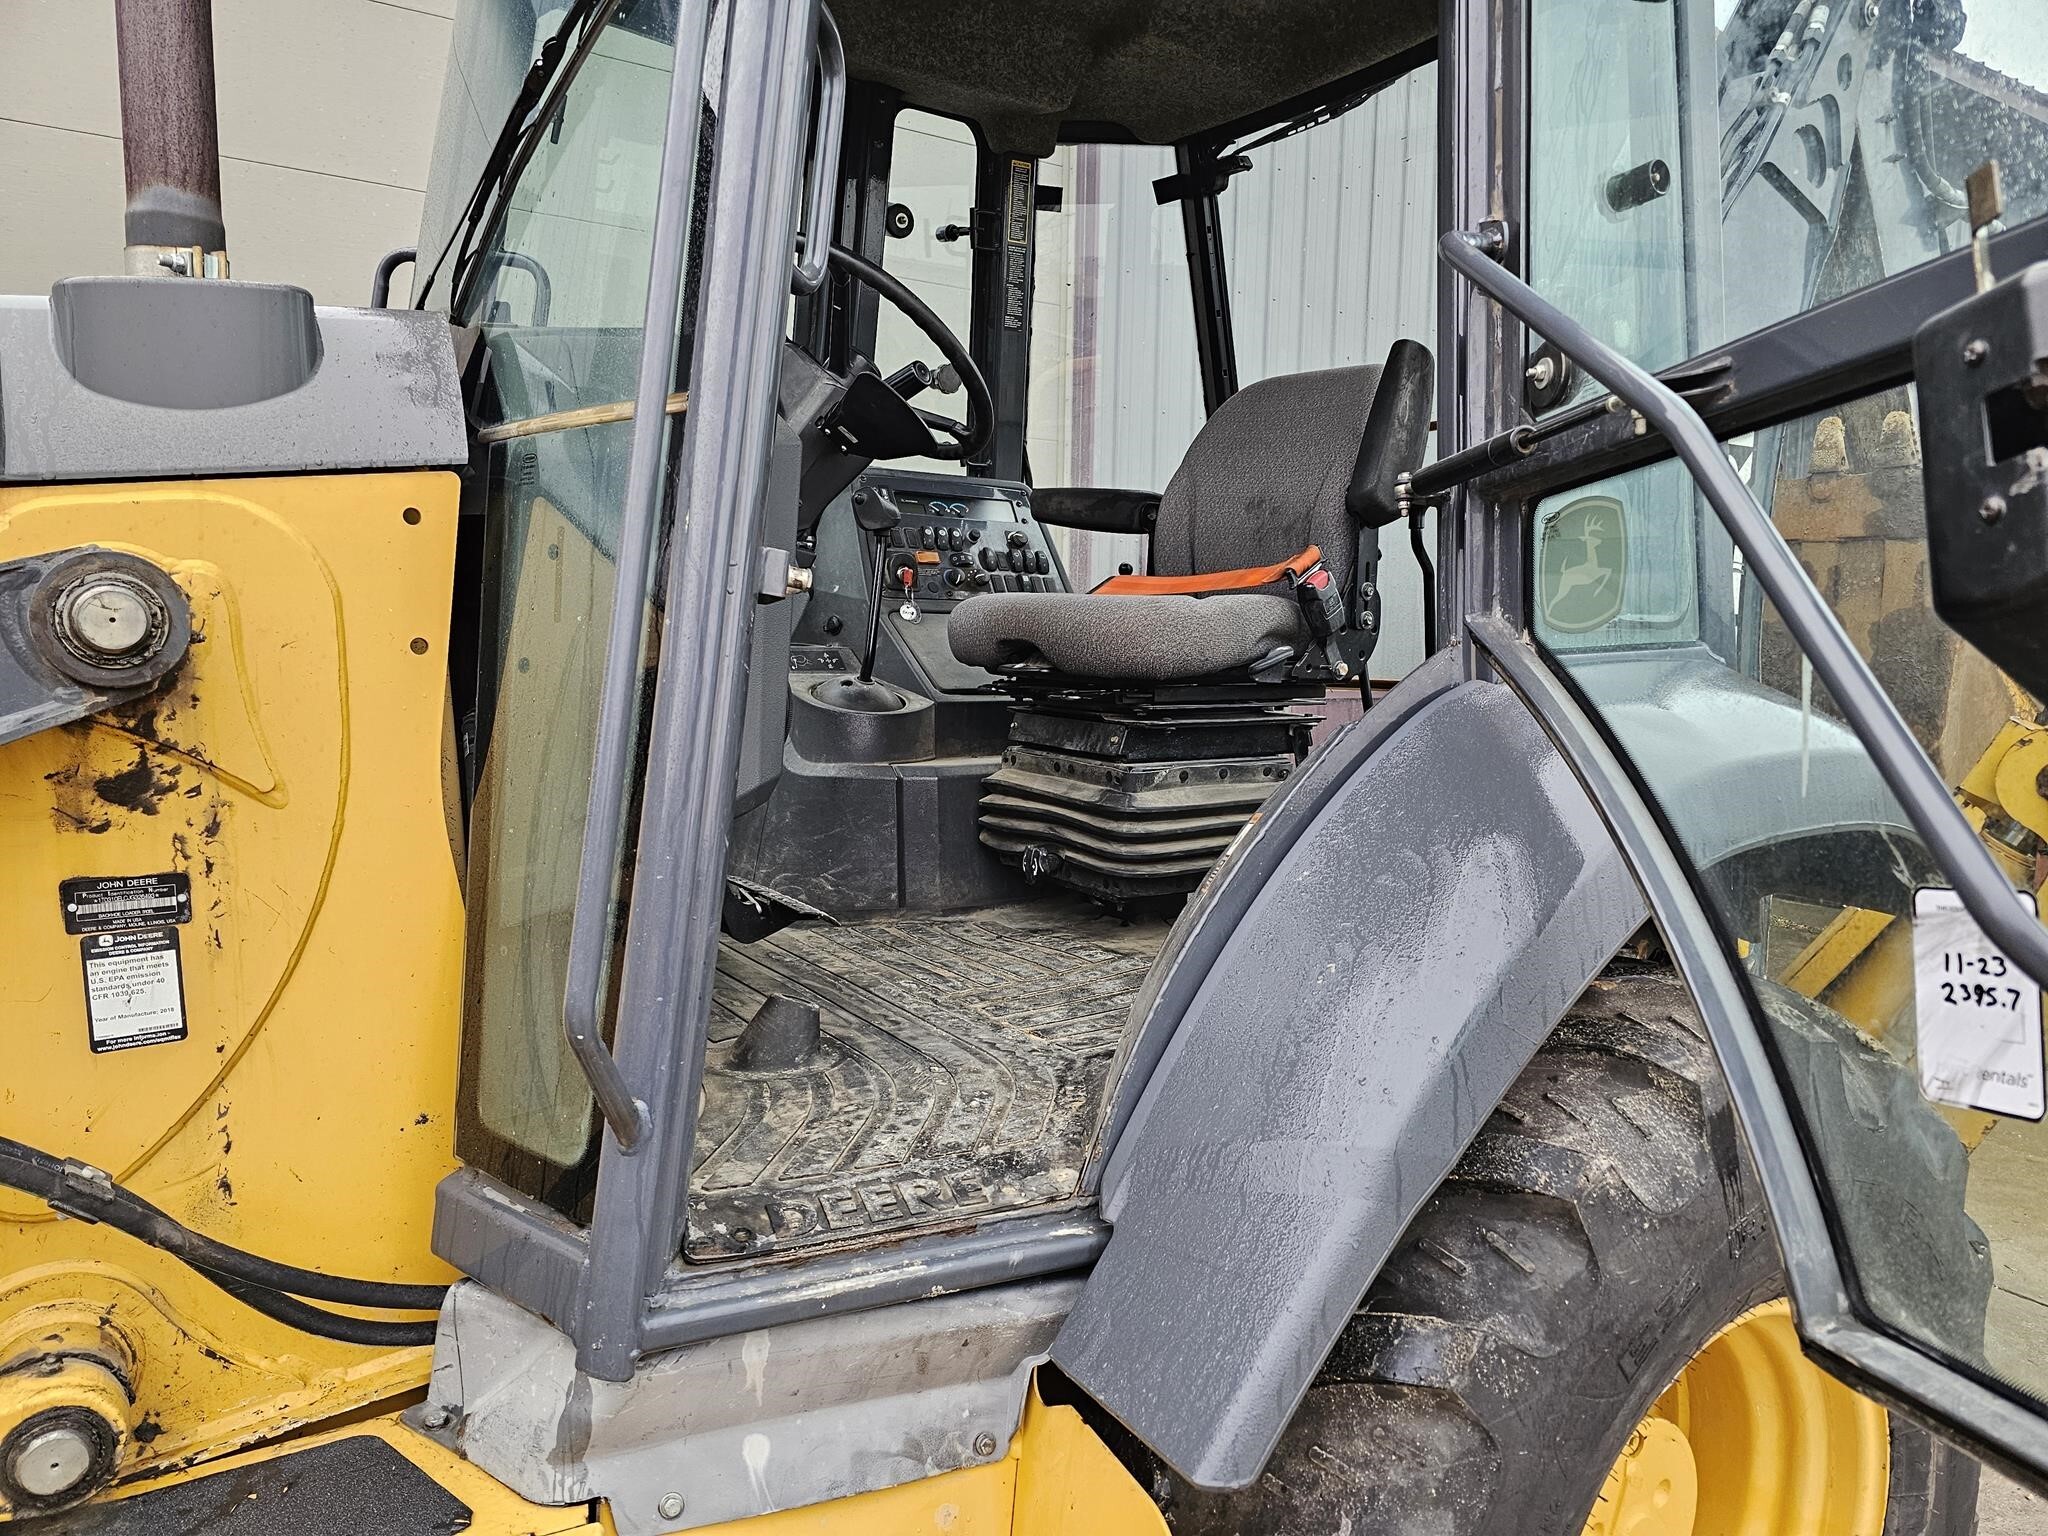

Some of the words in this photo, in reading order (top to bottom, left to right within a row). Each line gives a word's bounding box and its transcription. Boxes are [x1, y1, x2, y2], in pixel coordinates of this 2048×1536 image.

[97, 880, 124, 889] JOHN
[127, 877, 158, 887] DEERE
[115, 934, 137, 943] JOHN
[138, 939, 170, 947] INFORMATION
[89, 961, 106, 969] This
[108, 956, 149, 967] equipment
[150, 953, 164, 961] has
[1944, 952, 2007, 977] 11-23
[101, 966, 128, 976] engine
[129, 963, 145, 971] that
[146, 962, 169, 970] meets
[90, 977, 107, 985] U.S.
[108, 975, 125, 983] EPA
[126, 971, 161, 980] emission
[91, 983, 132, 993] standards
[132, 978, 154, 988] under
[156, 976, 165, 984] 40
[92, 993, 109, 1001] CFR
[1941, 981, 2021, 1012] 2395.7
[117, 1010, 159, 1020] Manufacture:
[764, 1171, 992, 1239] DEERE
